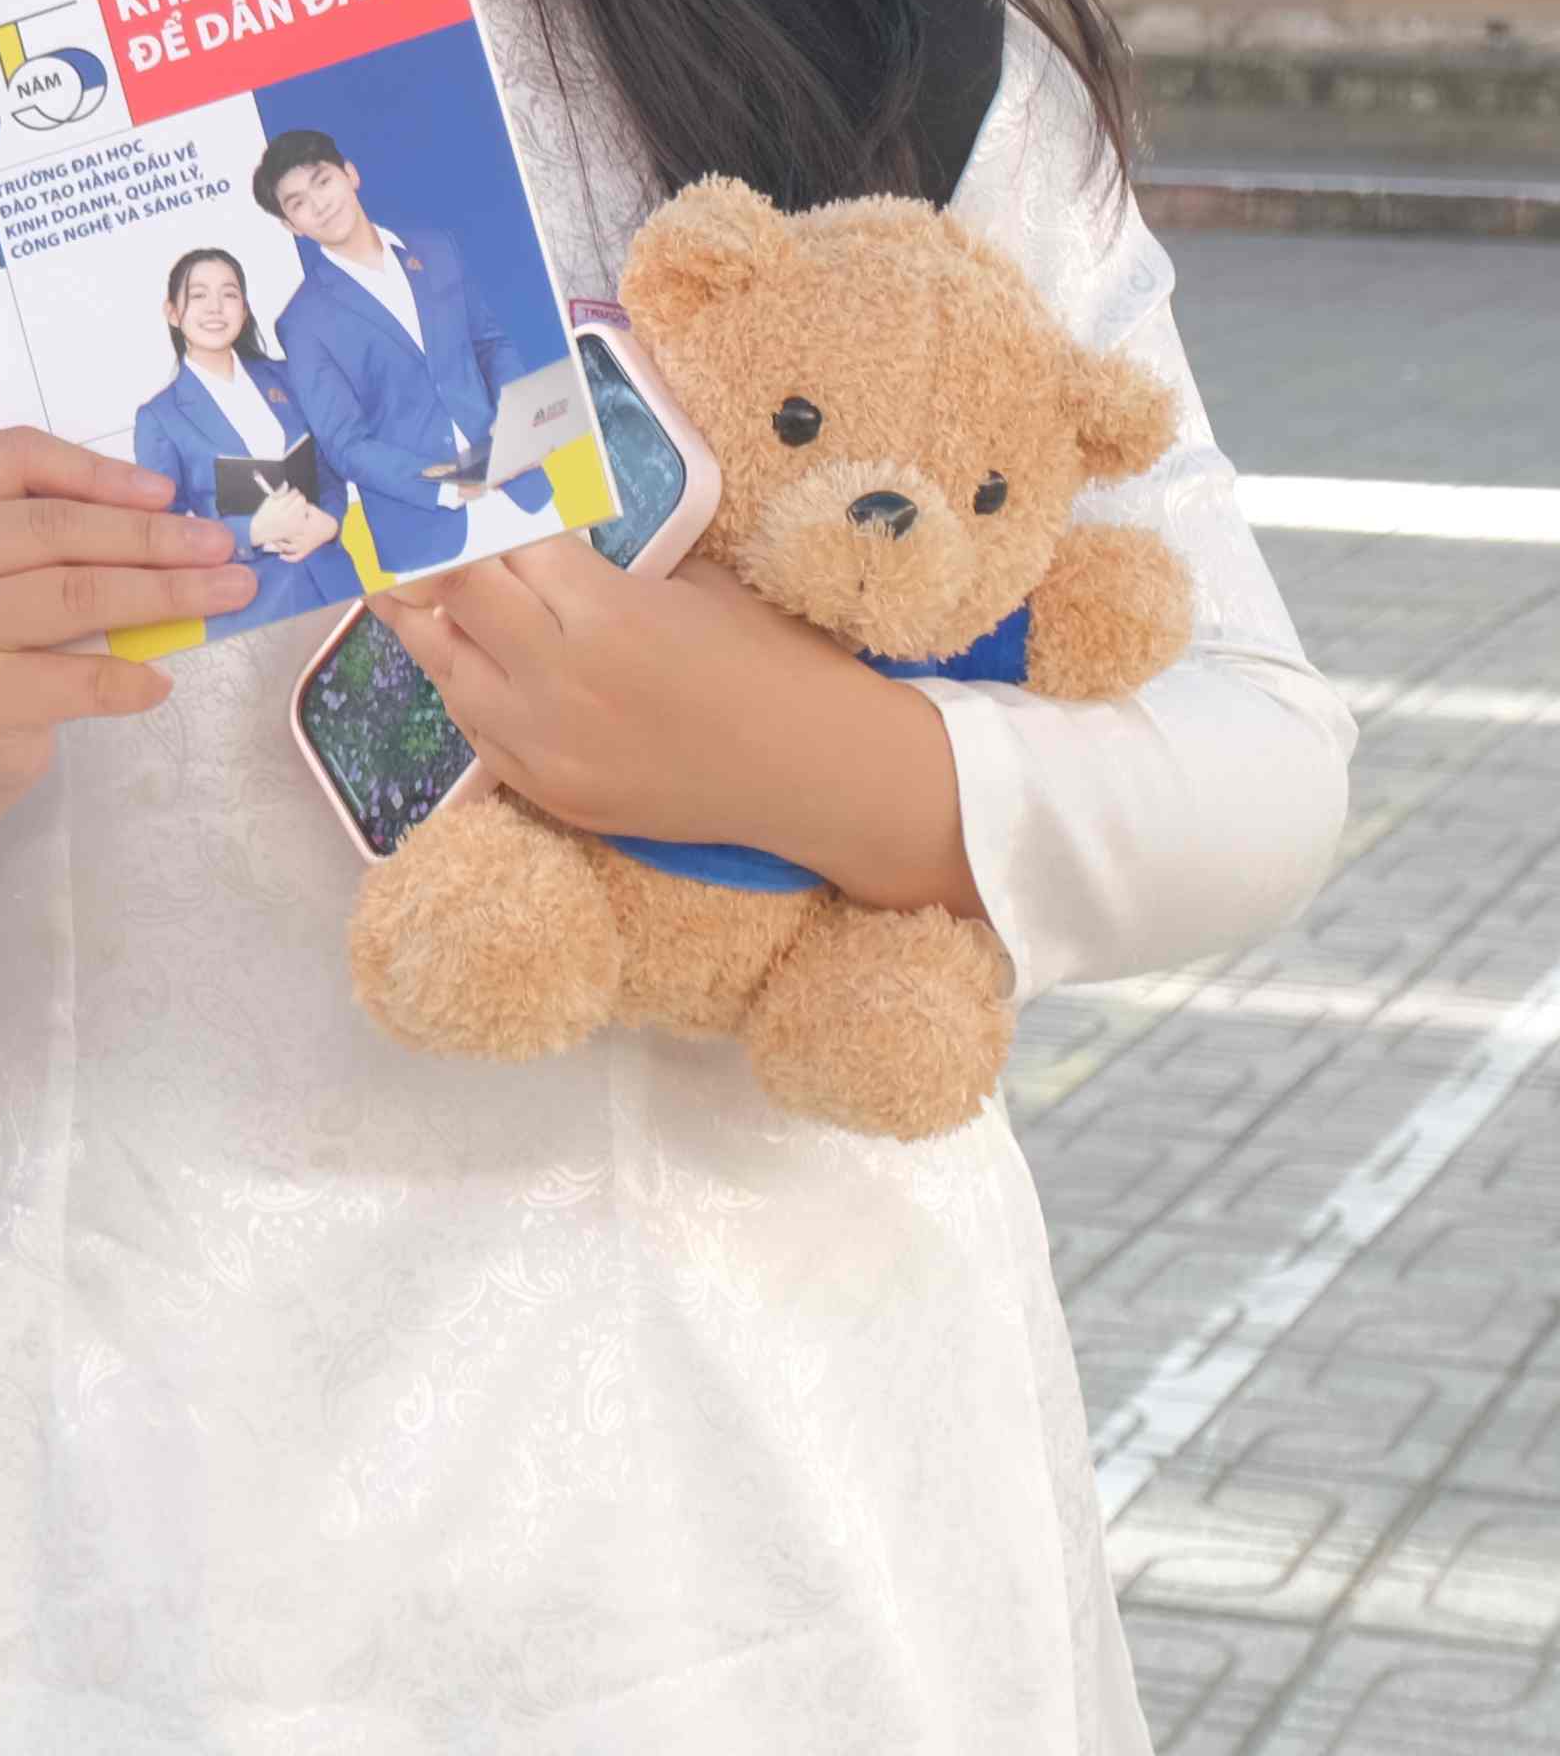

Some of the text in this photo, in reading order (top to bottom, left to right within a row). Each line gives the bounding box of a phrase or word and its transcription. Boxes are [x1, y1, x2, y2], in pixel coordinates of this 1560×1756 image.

[127, 9, 192, 73] ĐỂ
[15, 72, 63, 99] NĂM
[105, 138, 146, 166] HỌC
[3, 163, 205, 240] KINH DOANH, QUẢN LÝ,
[41, 182, 76, 206] TẠO
[77, 164, 130, 194] HÀNG
[10, 178, 232, 260] CÔNG NGHỆ VÀ SÁNG TẠO
